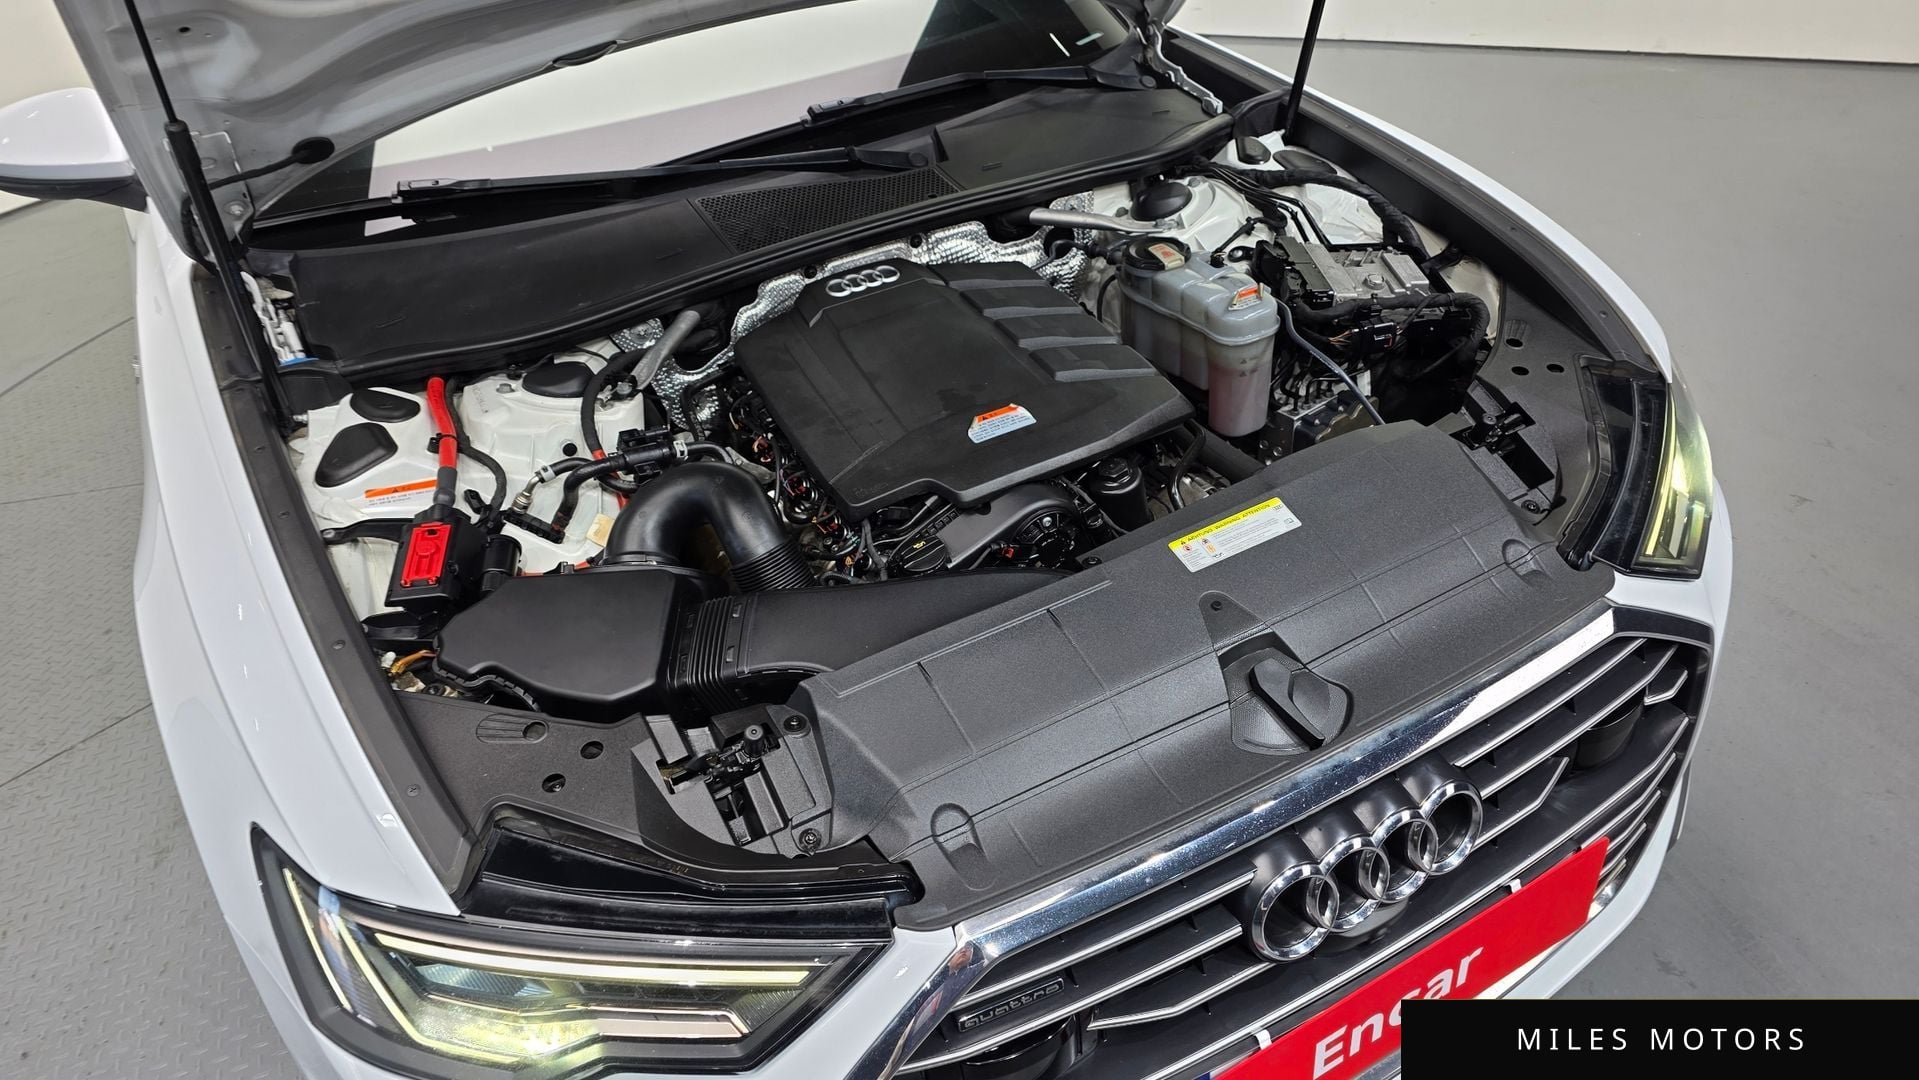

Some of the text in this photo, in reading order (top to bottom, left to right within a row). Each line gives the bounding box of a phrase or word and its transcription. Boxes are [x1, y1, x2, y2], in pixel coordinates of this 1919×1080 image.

[1215, 516, 1241, 530] WARNING
[1242, 504, 1270, 518] ATTENTION
[964, 983, 1060, 1028] quattro
